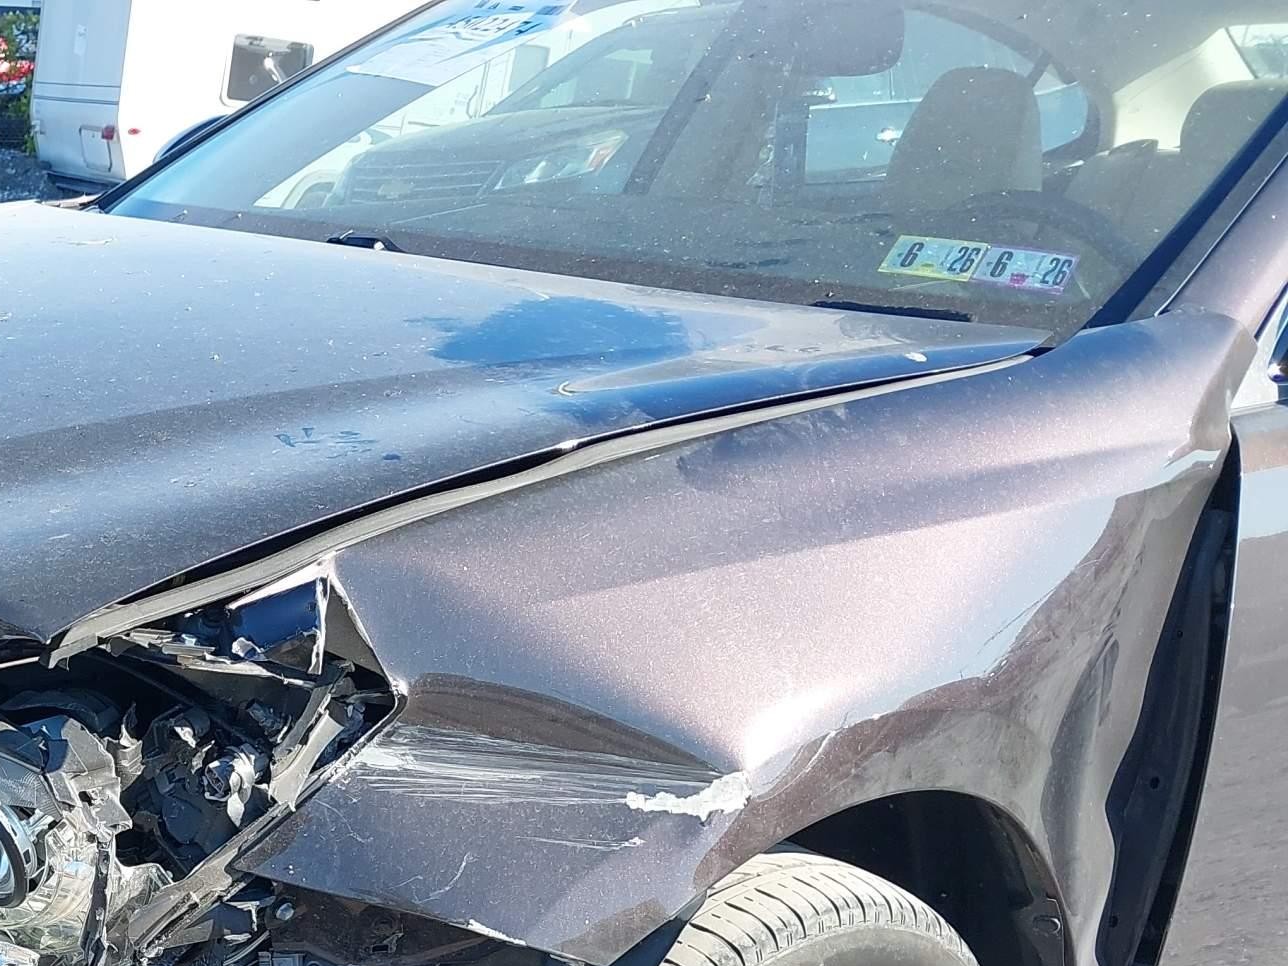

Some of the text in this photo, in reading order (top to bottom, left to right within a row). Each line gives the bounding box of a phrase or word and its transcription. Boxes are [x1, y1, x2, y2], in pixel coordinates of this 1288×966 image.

[900, 242, 982, 274] 6 26
[989, 250, 1072, 286] 6 26
